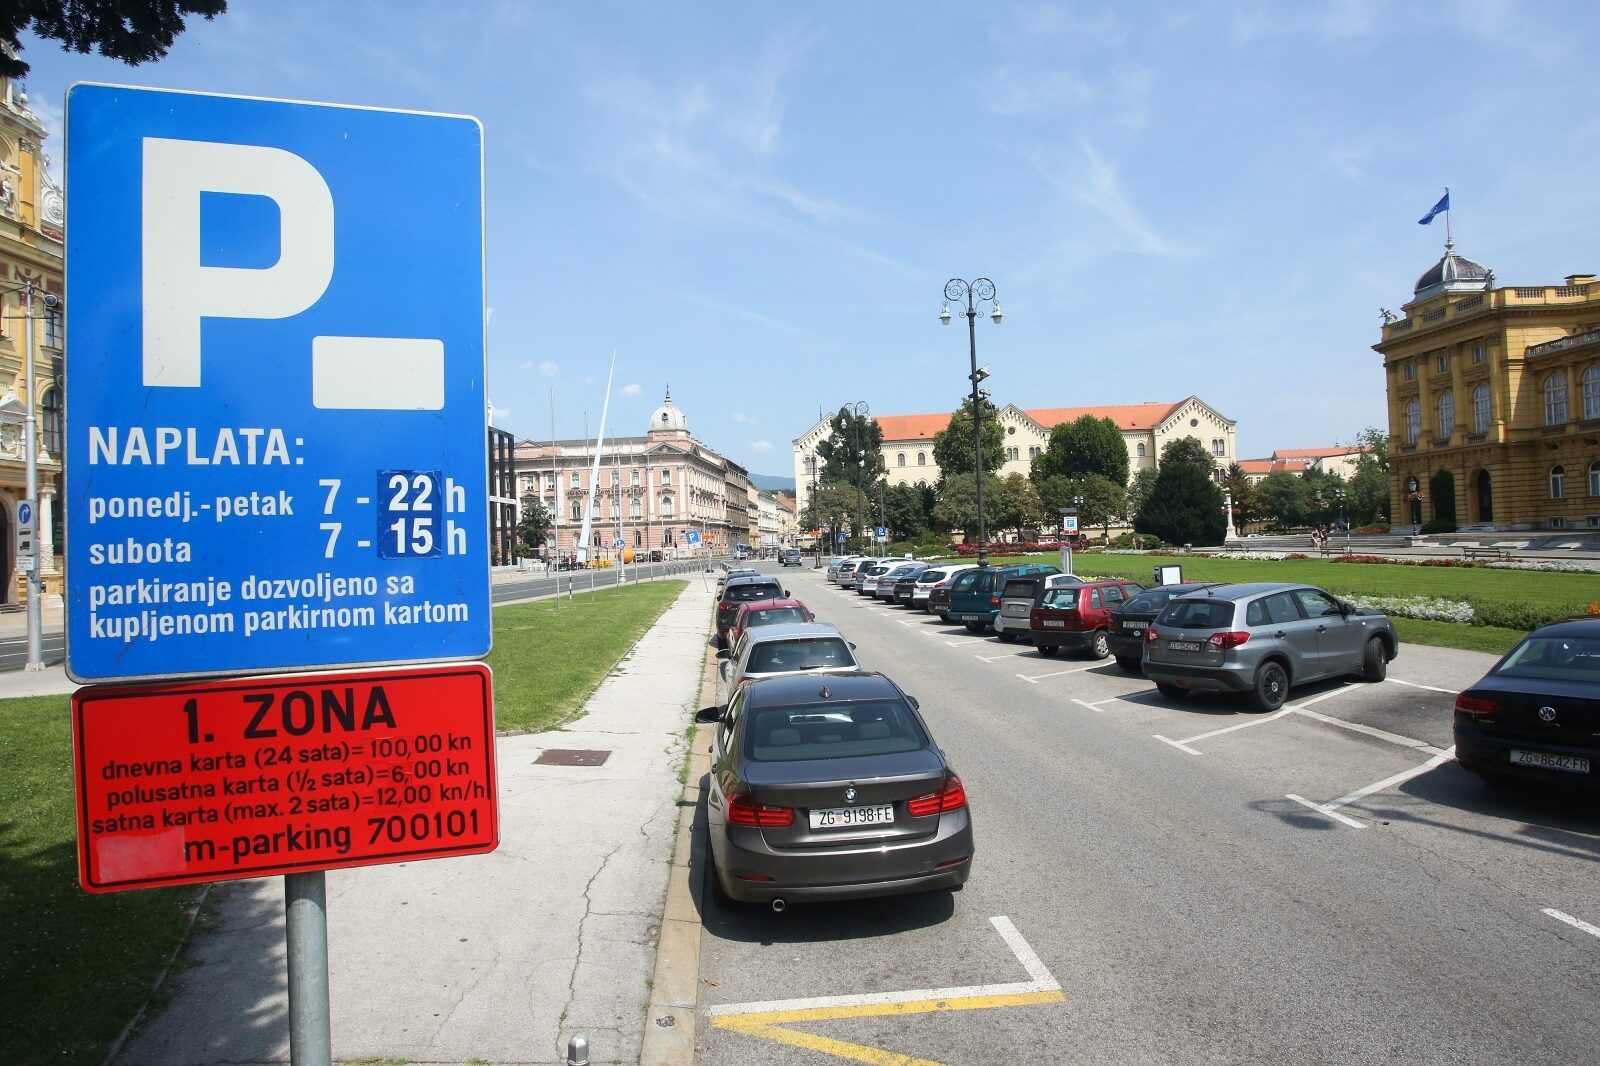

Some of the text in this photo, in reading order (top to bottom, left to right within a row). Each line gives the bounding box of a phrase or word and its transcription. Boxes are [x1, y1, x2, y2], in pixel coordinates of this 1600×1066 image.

[143, 137, 334, 388] P
[89, 426, 304, 465] NAPLATA:
[318, 479, 342, 515] 7
[388, 474, 433, 512] 22
[446, 477, 466, 513] h
[89, 537, 191, 565] subota
[319, 522, 343, 558] 7
[390, 517, 433, 554] 15
[447, 520, 467, 555] h
[90, 573, 415, 611] parkiranje dozvoljeno sa
[90, 600, 469, 642] kupljenom parkirnom kartom
[183, 686, 397, 744] 1. ZONA
[102, 758, 182, 780] dnevna
[190, 753, 246, 773] karta
[254, 745, 292, 769] (24
[448, 733, 471, 751] kn
[1519, 752, 1533, 763] ZG
[92, 813, 155, 834] satna
[162, 808, 218, 827] karta
[224, 802, 285, 824] (max.
[289, 796, 303, 815] 2
[440, 780, 485, 802] kn/h
[106, 782, 216, 811] polusatna
[223, 775, 279, 795] karta
[447, 758, 470, 776] kn
[184, 809, 478, 864] m-parking 700101
[820, 810, 835, 825] ZG
